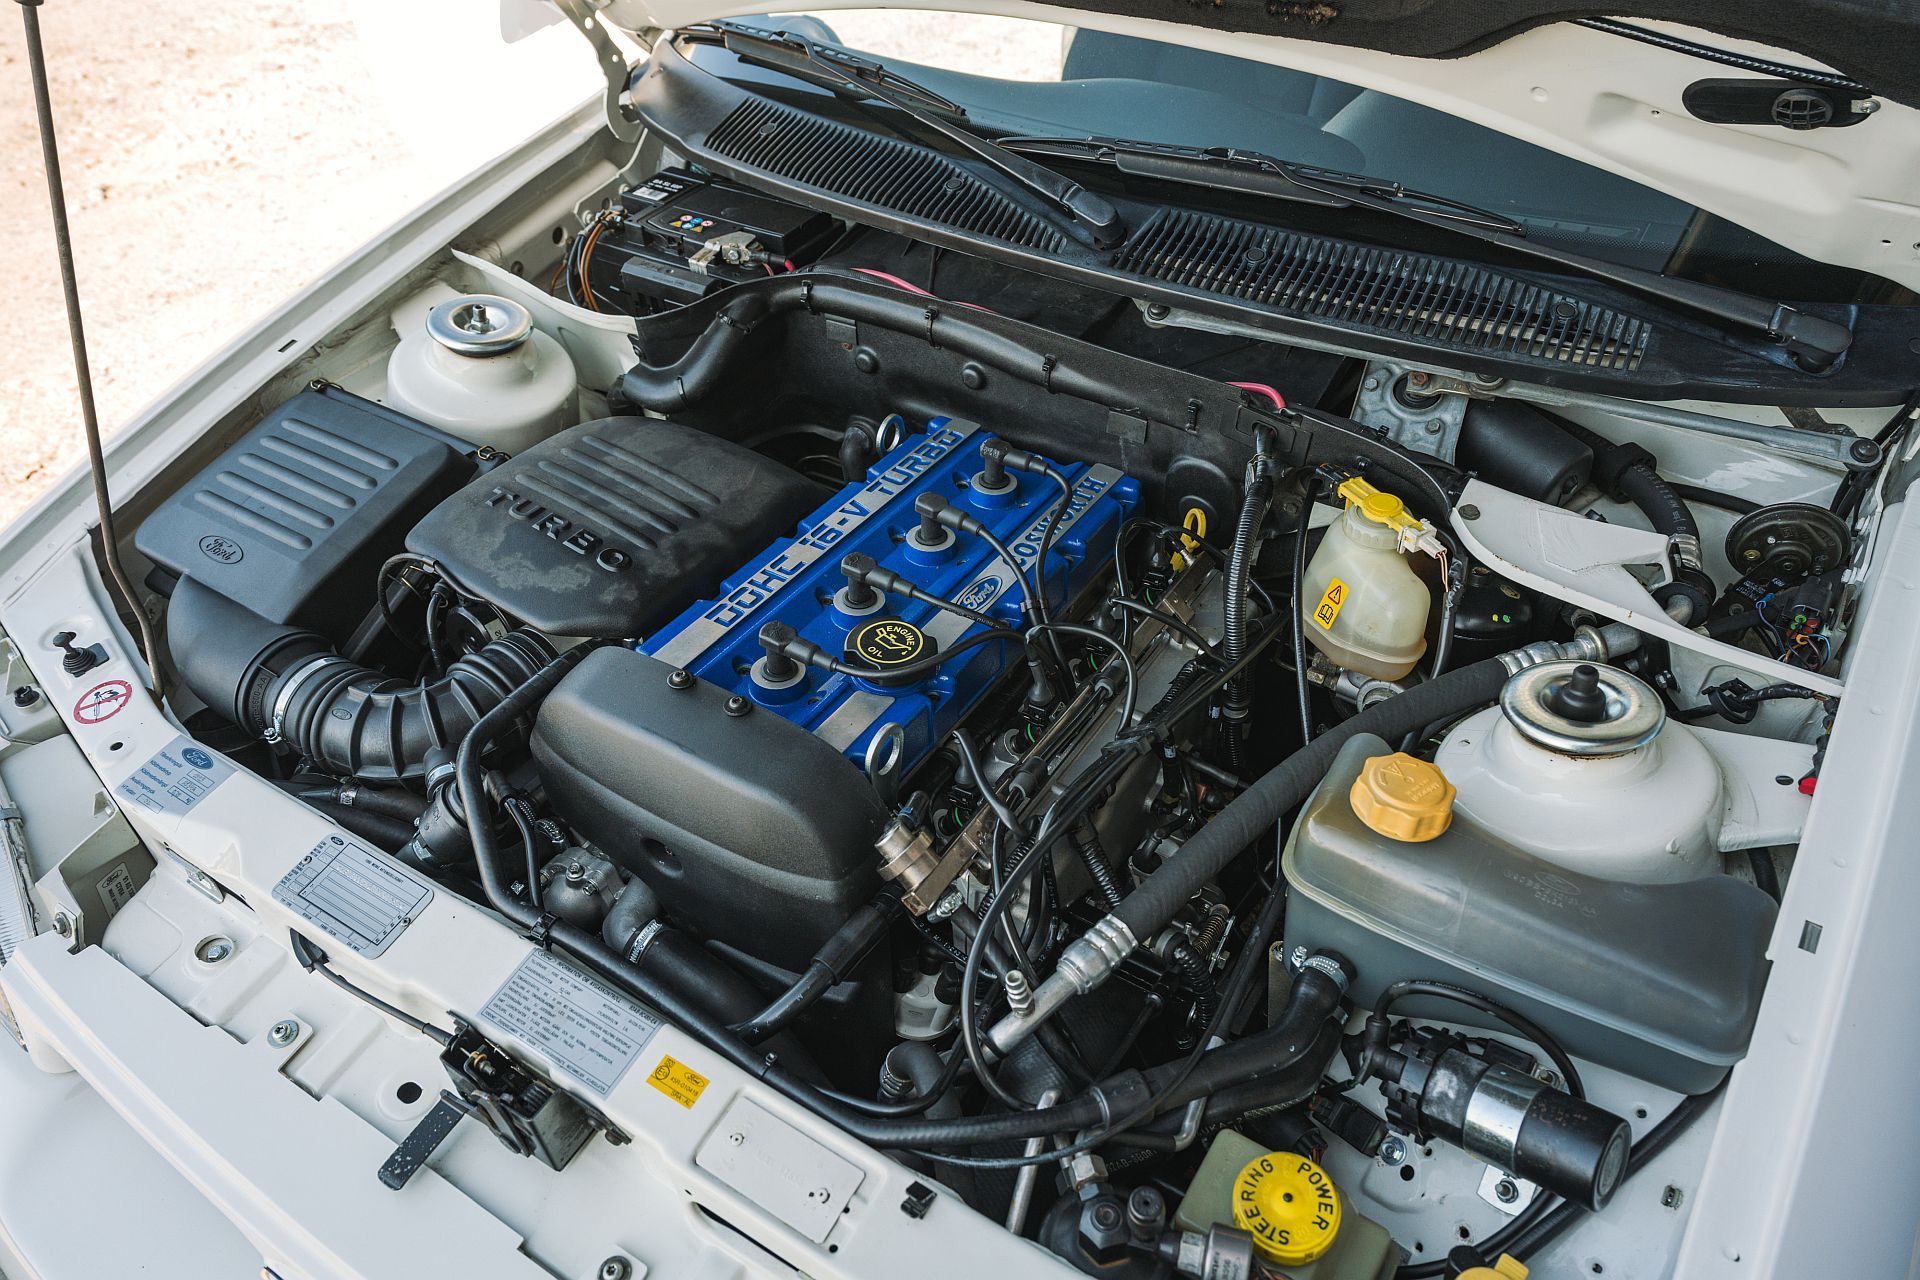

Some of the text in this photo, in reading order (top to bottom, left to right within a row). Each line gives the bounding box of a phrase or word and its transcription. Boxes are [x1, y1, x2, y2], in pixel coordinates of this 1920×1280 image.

[485, 485, 633, 573] TURBO
[704, 428, 965, 628] DOHC 16-V TURBO
[867, 646, 883, 658] OIL
[886, 625, 915, 646] ENGINE
[1241, 1159, 1291, 1246] STEERING
[1297, 1162, 1334, 1231] POWER
